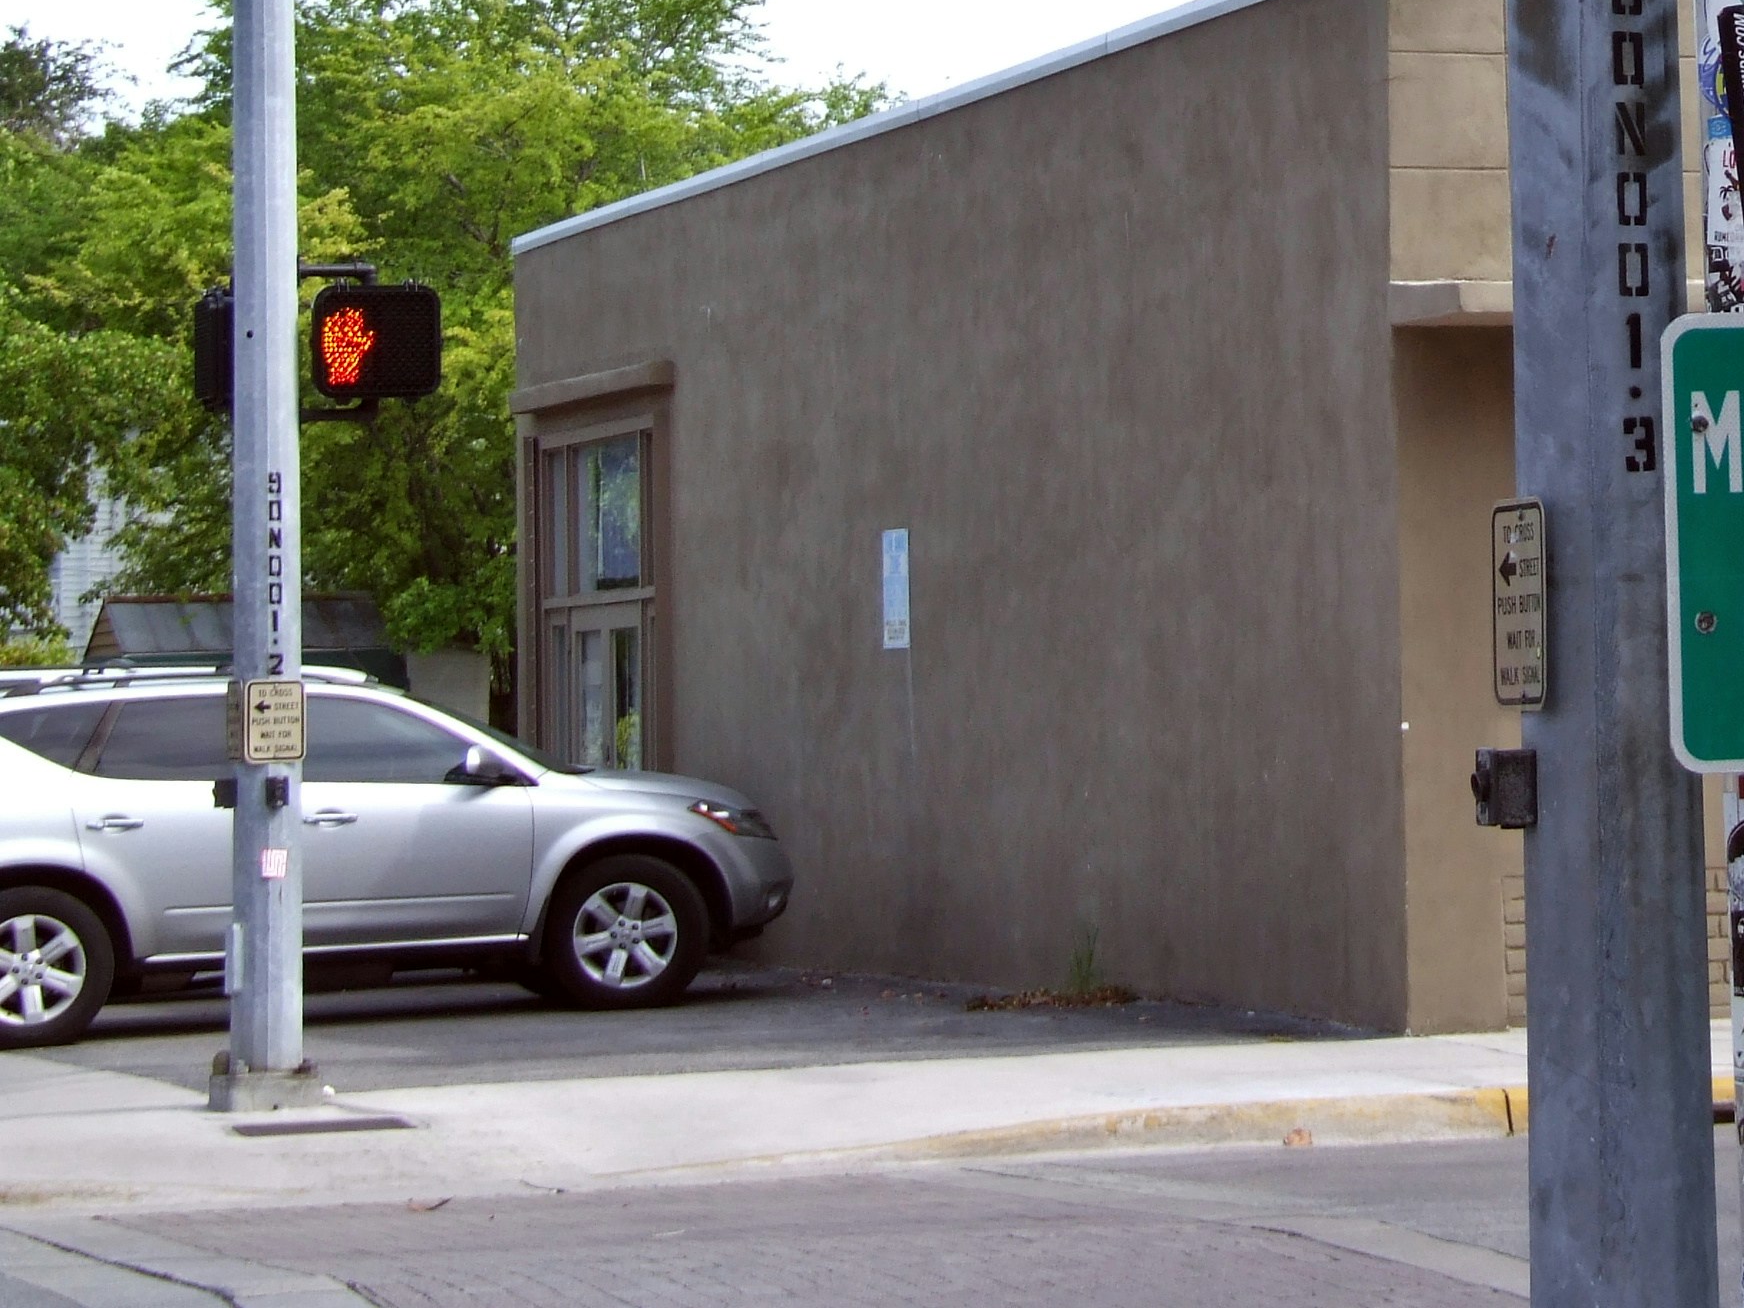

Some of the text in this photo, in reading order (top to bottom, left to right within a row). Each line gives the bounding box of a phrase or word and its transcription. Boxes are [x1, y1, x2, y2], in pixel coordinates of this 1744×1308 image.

[1503, 523, 1534, 543] TO CROSS
[1519, 557, 1539, 578] STREET
[1498, 593, 1541, 616] PUSH BUTTON
[1507, 629, 1535, 649] WAIT FOR
[1501, 665, 1541, 685] WALK SIGNAL
[270, 688, 293, 697] CROSS
[274, 701, 299, 711] STREET
[252, 715, 300, 726] PUSH BUTTON
[260, 730, 292, 739] WAIT FOR
[253, 743, 298, 753] WALK SIGNAL
